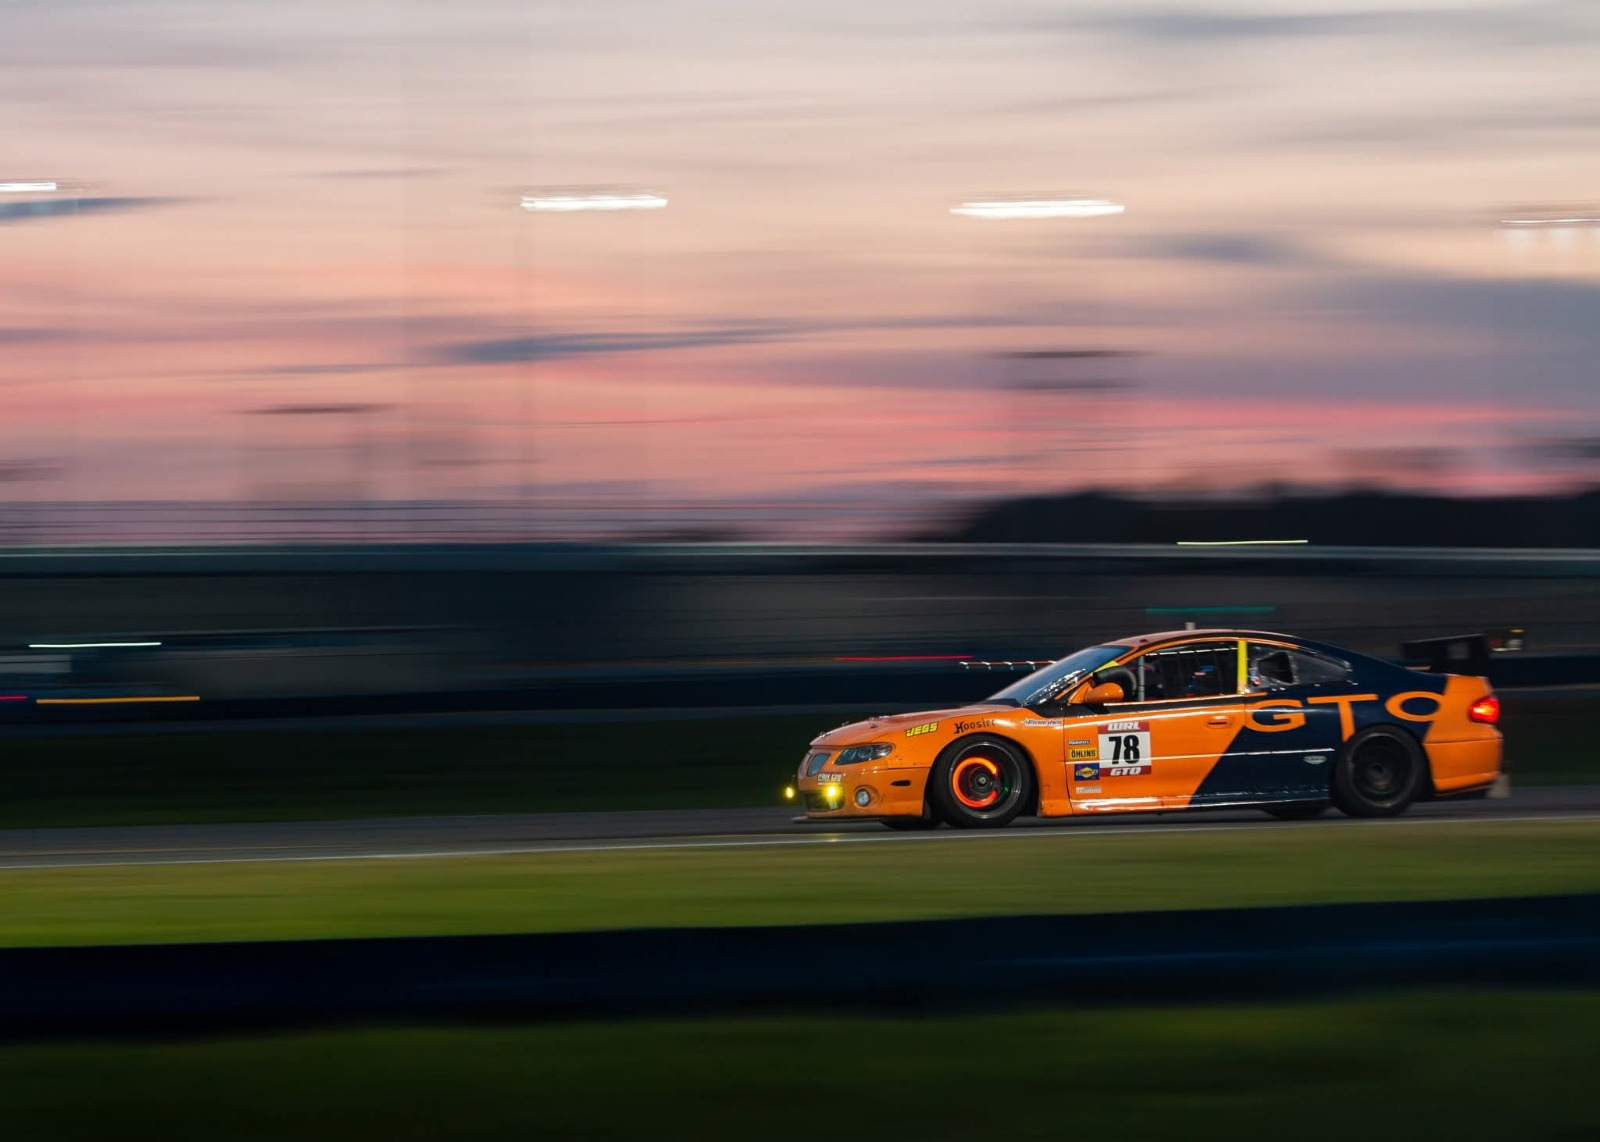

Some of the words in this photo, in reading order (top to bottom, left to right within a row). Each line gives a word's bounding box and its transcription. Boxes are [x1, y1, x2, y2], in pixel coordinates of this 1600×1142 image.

[1244, 690, 1443, 743] GTO
[905, 722, 938, 737] JEGS
[954, 718, 997, 733] Hoosier
[1108, 721, 1141, 731] WRL
[1108, 735, 1140, 764] 78
[1110, 767, 1142, 776] GTO
